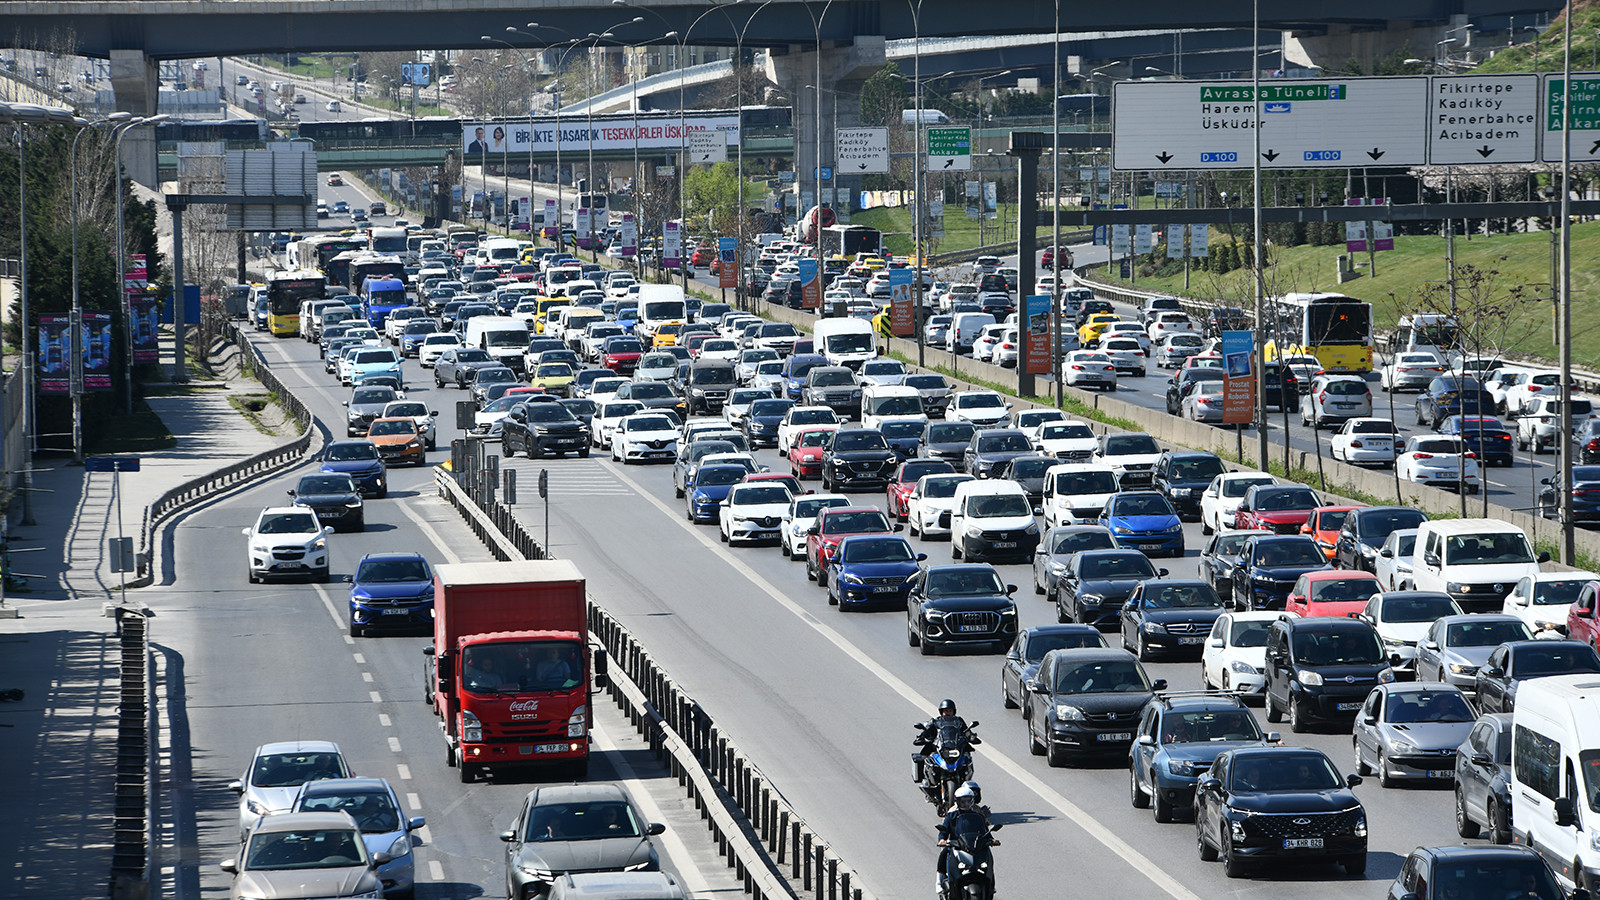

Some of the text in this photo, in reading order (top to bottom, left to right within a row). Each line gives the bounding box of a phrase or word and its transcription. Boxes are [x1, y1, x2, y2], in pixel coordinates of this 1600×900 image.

[1274, 87, 1328, 98] Tüneli
[1440, 83, 1513, 95] Fikirtepe
[1202, 103, 1255, 113] Harem
[1439, 98, 1503, 110] Kadıköy
[1202, 116, 1266, 129] Üsküdar
[1439, 113, 1534, 125] Fenerbahçe
[515, 128, 553, 143] BİRİKTE
[1439, 129, 1519, 140] Acıbadem
[1286, 839, 1294, 847] 34
[1297, 839, 1309, 847] KHR
